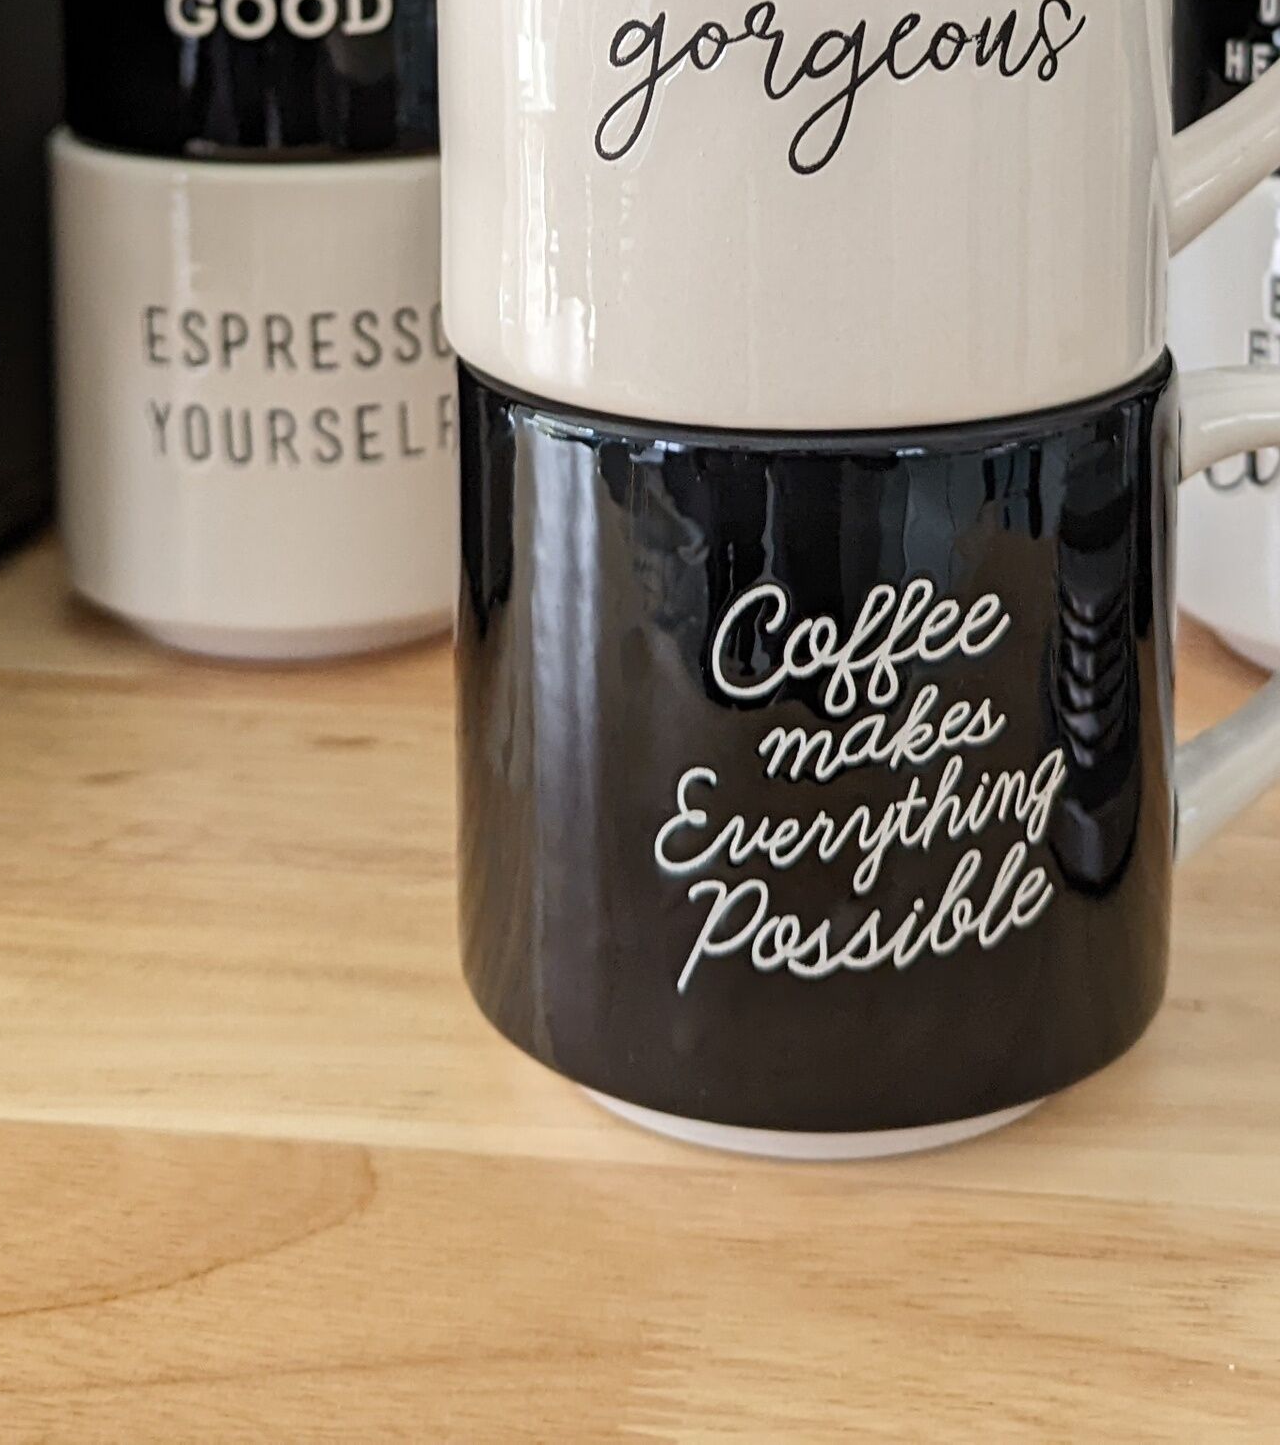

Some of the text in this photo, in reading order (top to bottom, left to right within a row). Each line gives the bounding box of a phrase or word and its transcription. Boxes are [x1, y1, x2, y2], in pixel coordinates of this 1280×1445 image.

[711, 577, 1012, 715] Coffee
[756, 683, 1008, 782] makes
[652, 747, 1067, 896] Everything
[674, 841, 1055, 995] Possible
